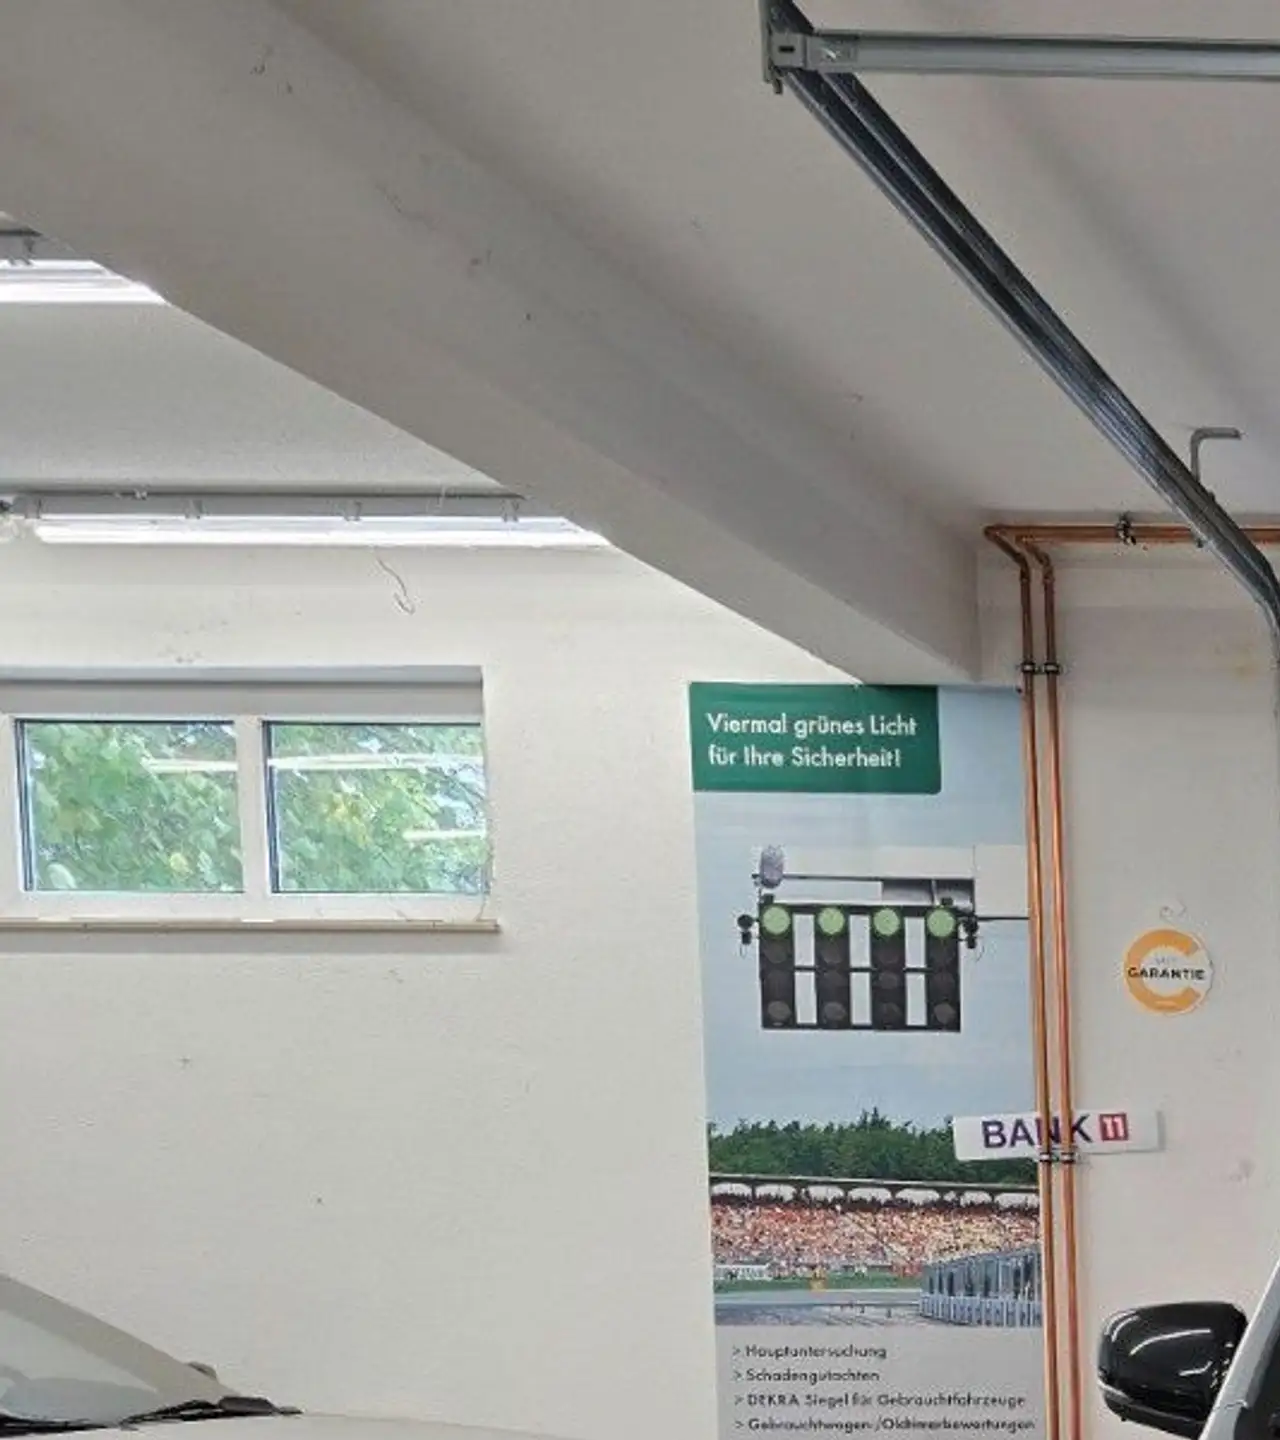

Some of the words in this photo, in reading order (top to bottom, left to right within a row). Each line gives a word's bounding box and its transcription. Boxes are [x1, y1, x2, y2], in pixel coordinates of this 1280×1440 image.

[706, 713, 788, 734] Viermal
[794, 715, 864, 738] grünes
[871, 714, 917, 736] Licht
[708, 744, 737, 766] für
[744, 744, 784, 766] Ihre
[791, 746, 901, 768] Sicherheit!
[1127, 966, 1205, 981] GARANTIE
[748, 1394, 799, 1406] DEKRA
